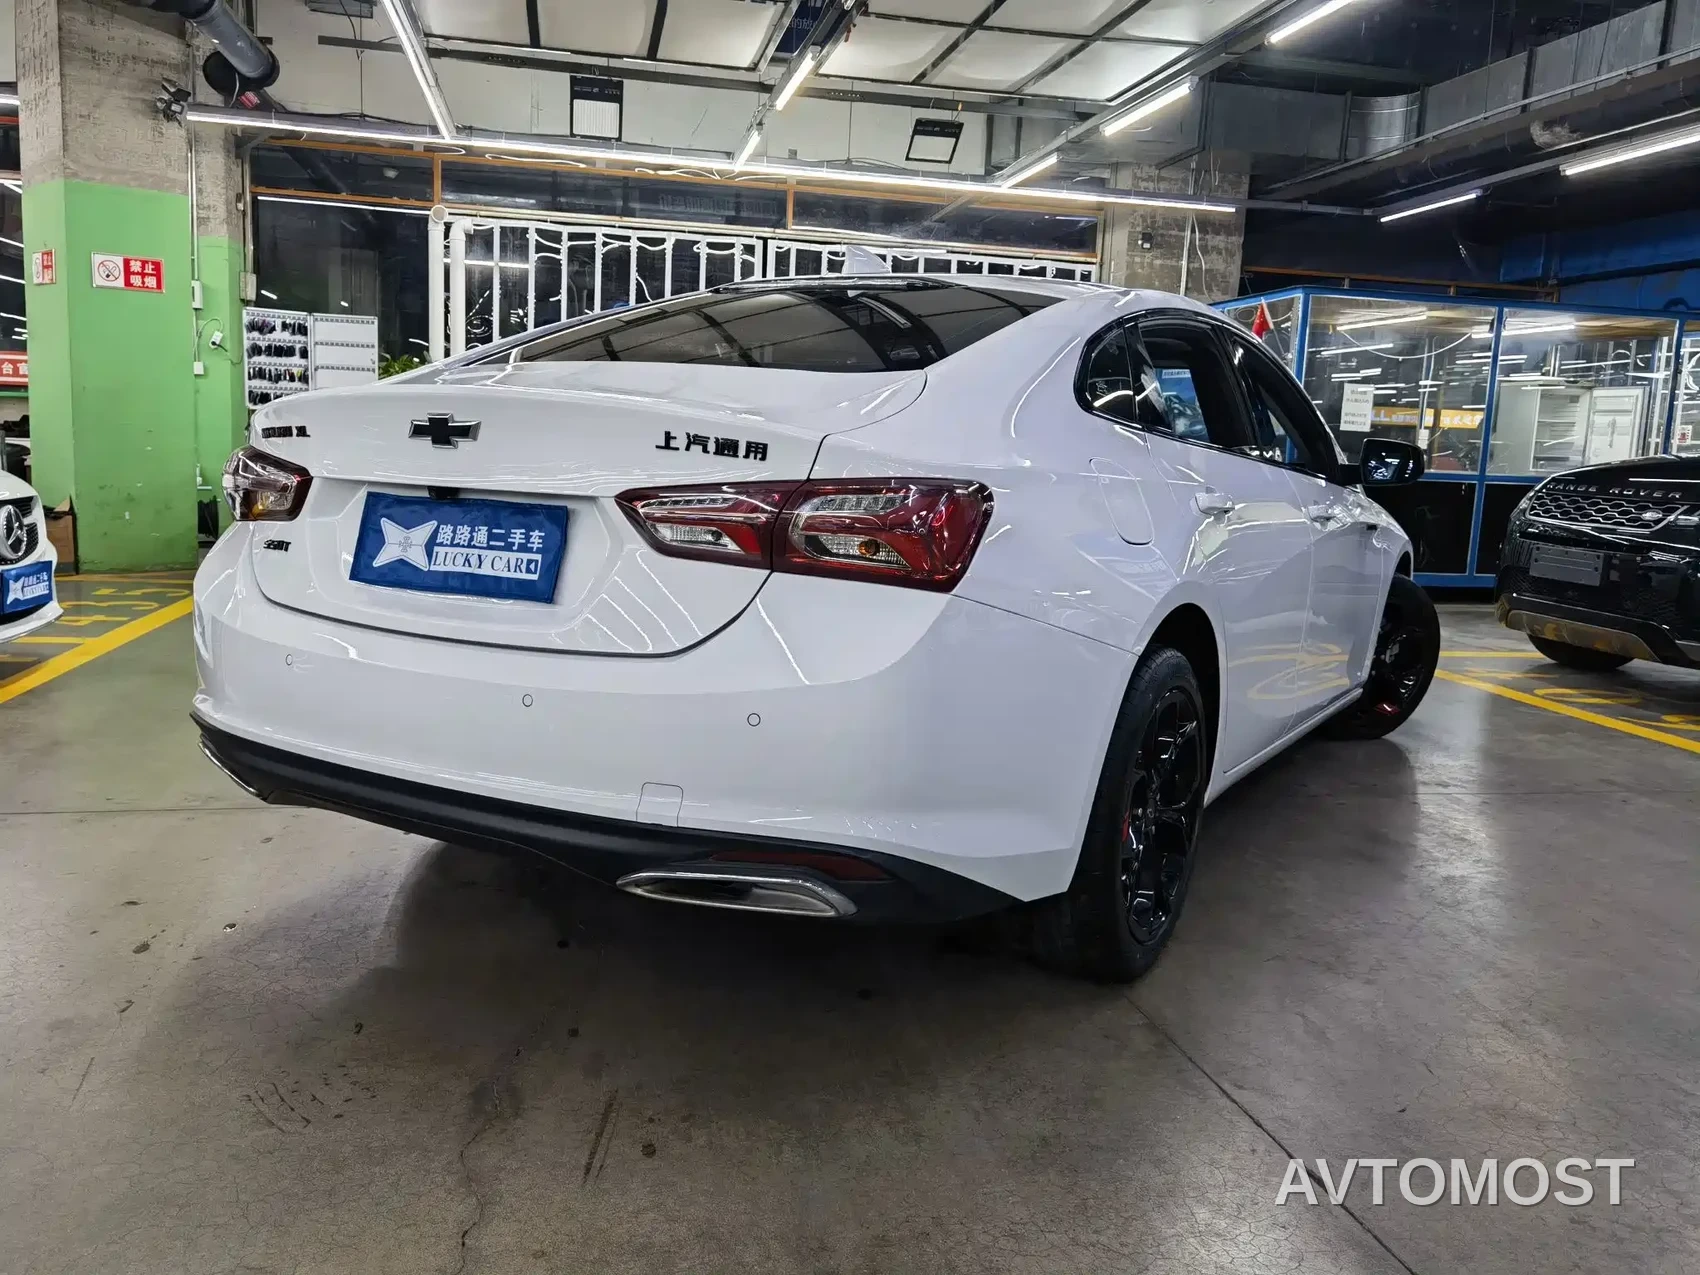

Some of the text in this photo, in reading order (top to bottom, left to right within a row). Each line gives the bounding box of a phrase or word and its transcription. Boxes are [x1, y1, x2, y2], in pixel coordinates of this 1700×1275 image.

[129, 260, 157, 274] 禁止
[130, 274, 157, 289] 吸烟
[655, 430, 769, 461] 上汽通用
[1547, 482, 1683, 499] RANGE ROVER
[436, 524, 545, 552] 路路通二手车
[433, 551, 524, 574] LUCKY CAR
